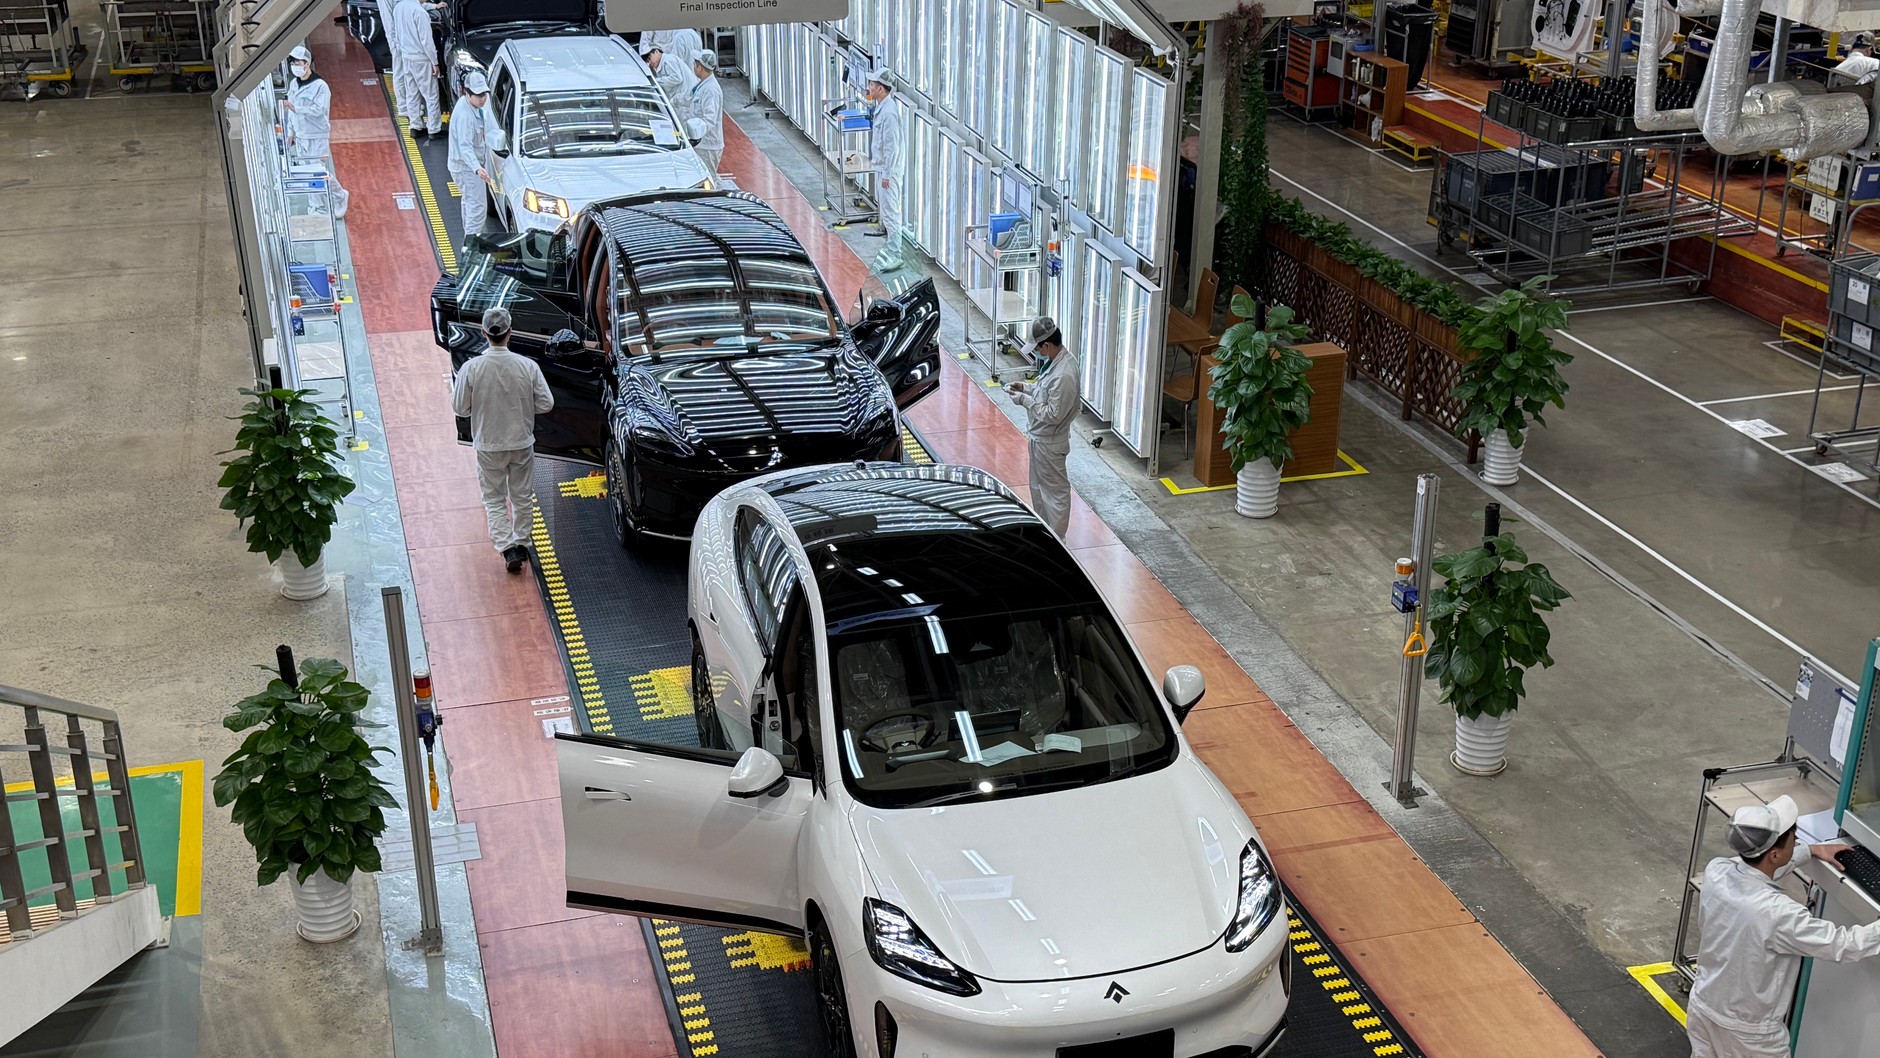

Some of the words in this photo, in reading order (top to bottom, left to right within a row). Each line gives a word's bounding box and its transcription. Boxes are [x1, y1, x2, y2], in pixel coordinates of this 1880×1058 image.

[680, 3, 704, 12] Final
[706, 0, 755, 11] Inspection
[757, 0, 778, 8] Line
